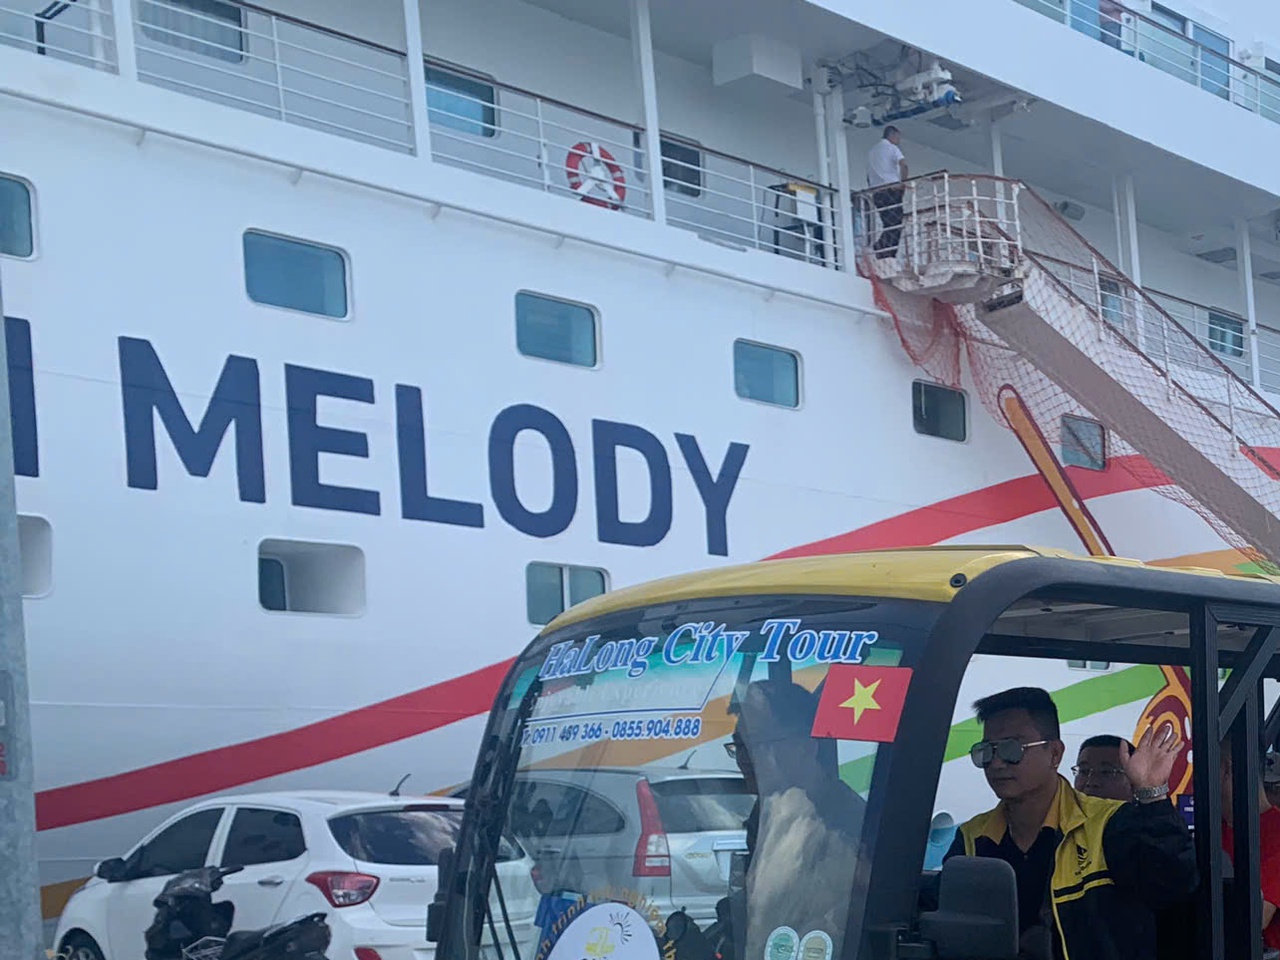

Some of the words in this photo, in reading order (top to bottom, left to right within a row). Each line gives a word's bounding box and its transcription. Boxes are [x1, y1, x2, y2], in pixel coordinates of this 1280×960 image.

[118, 335, 749, 556] MELODY
[538, 634, 659, 680] HaLong
[662, 621, 749, 668] City
[758, 618, 879, 665] Tour
[531, 726, 557, 745] 0911
[581, 721, 603, 740] 366
[611, 716, 701, 740] 0855.904.888
